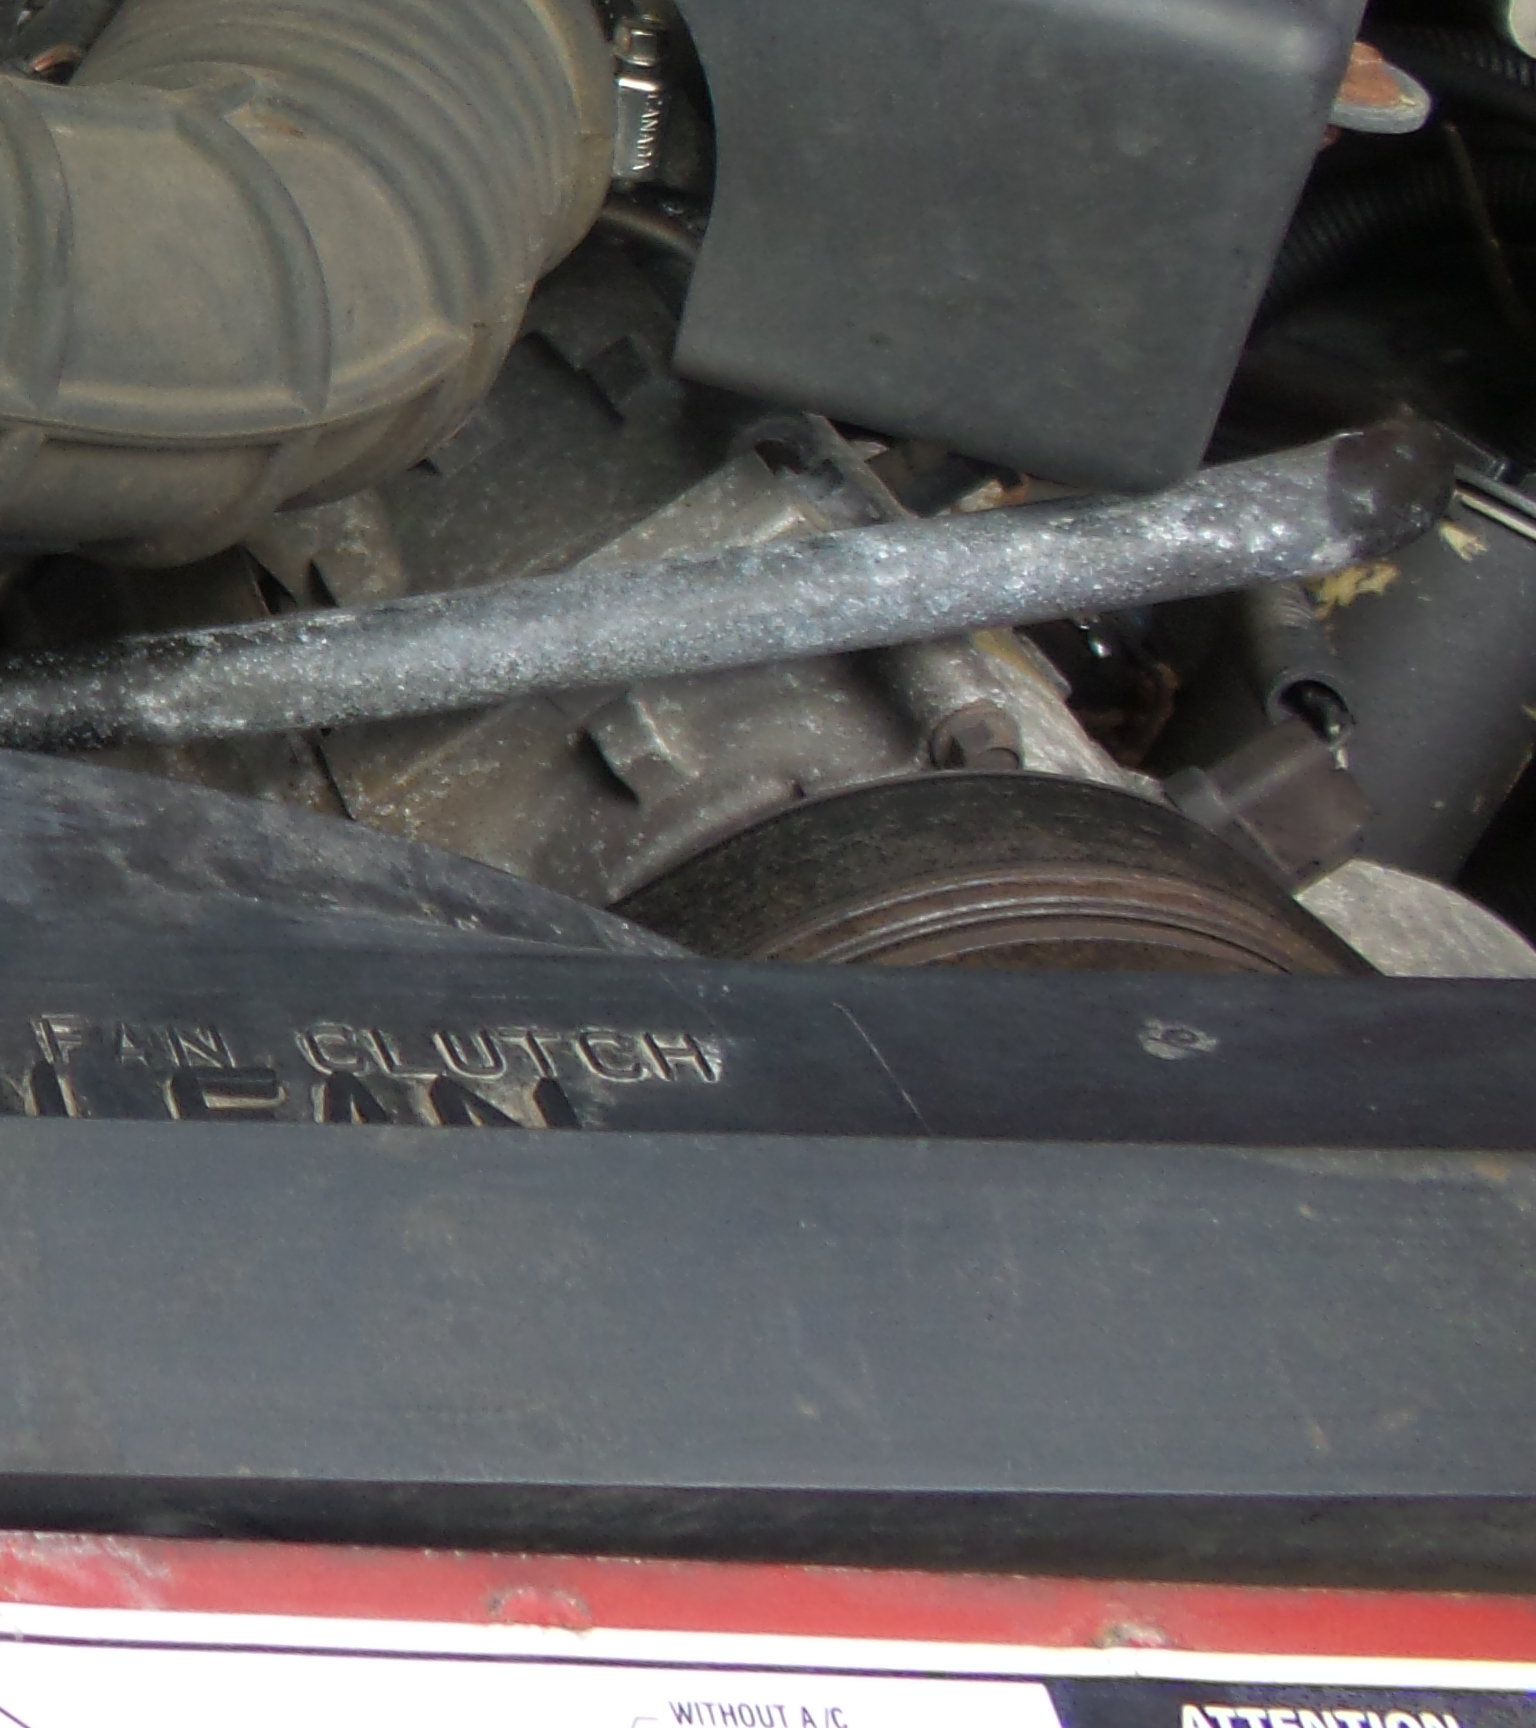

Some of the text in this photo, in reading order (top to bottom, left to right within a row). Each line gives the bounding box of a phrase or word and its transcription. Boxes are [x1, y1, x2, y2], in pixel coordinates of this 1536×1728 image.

[33, 1012, 240, 1069] FAN
[295, 1019, 724, 1084] CLUTCH
[667, 1700, 789, 1728] WITHOUT
